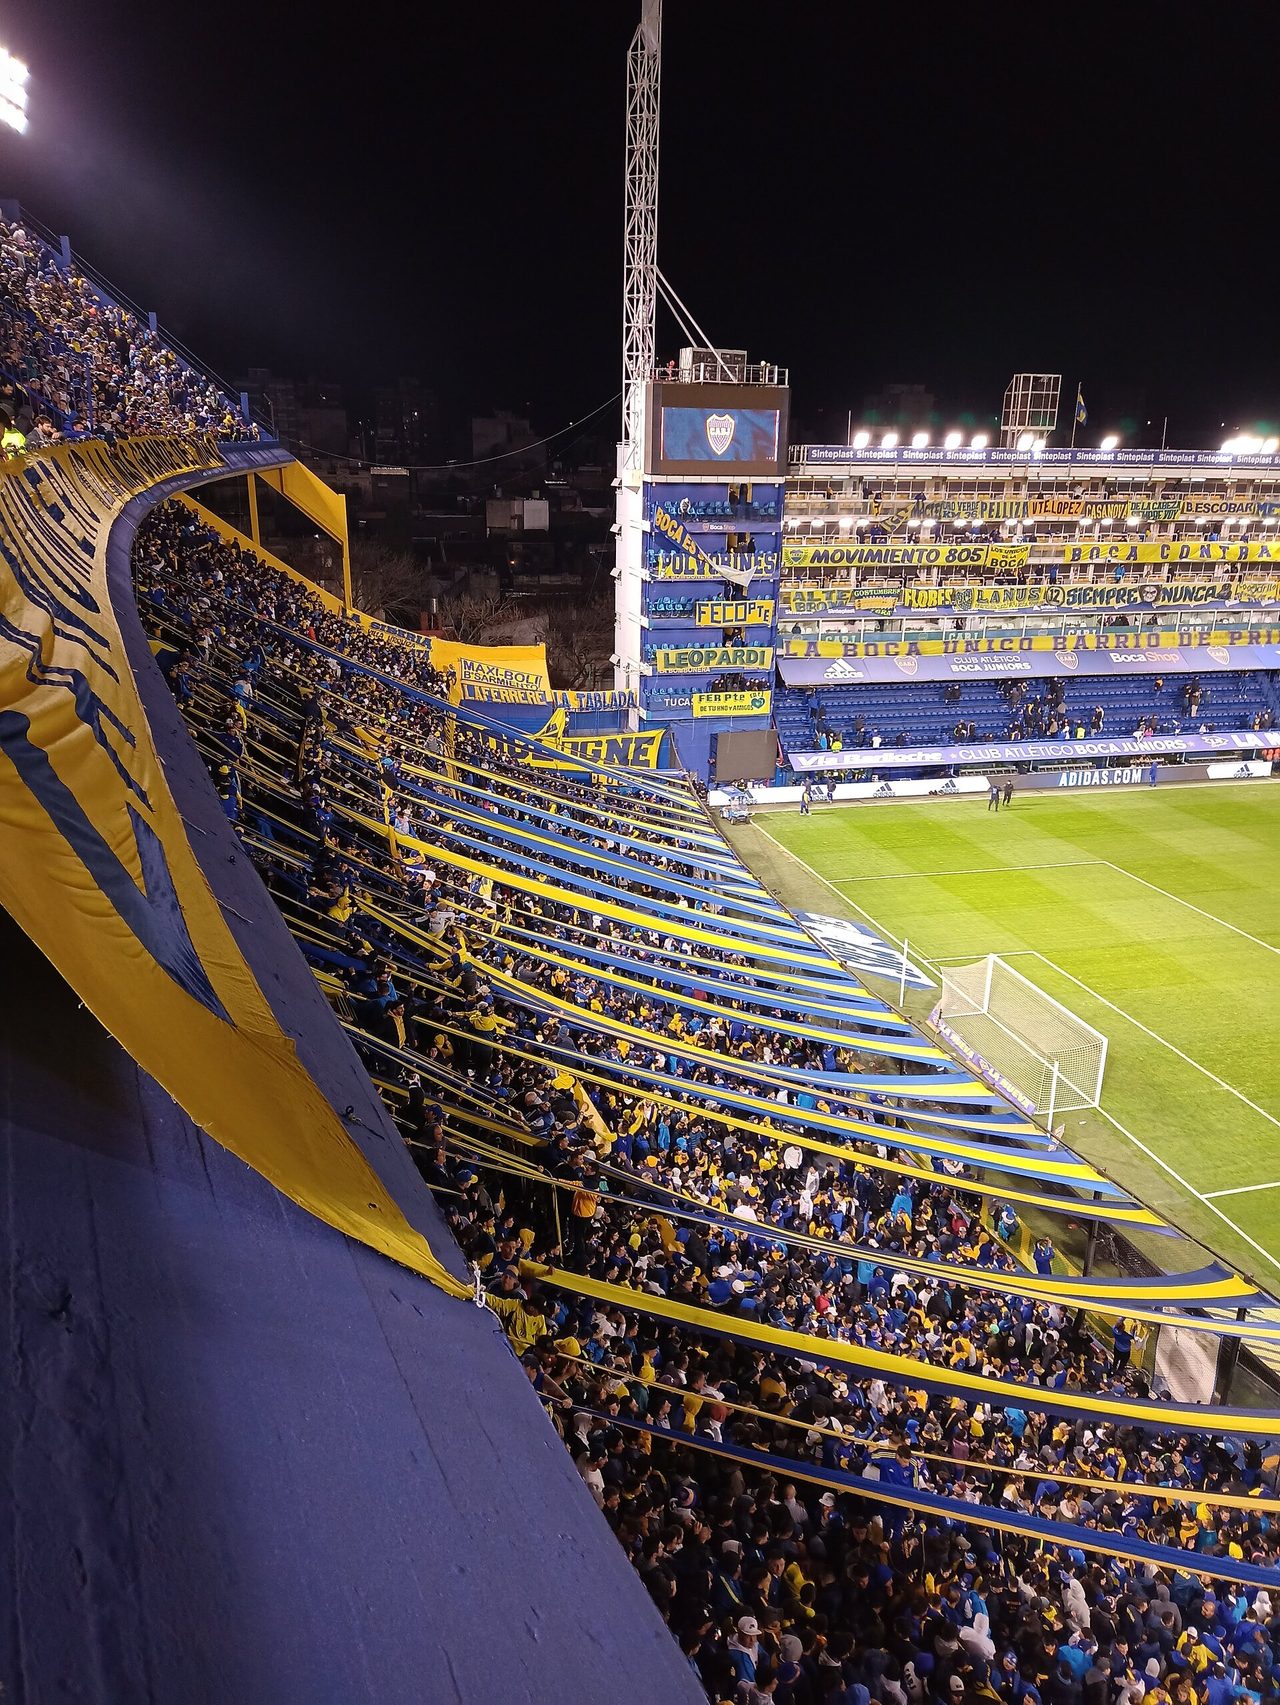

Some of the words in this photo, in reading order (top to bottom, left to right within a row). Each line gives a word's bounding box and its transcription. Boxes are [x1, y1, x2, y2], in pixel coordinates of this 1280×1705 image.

[811, 450, 853, 460] Sinteplast
[856, 450, 898, 460] Sinteplast
[902, 450, 943, 460] Sinteplast
[945, 450, 986, 461] Sinteplast
[991, 451, 1031, 461] Sinteplast
[1076, 452, 1114, 462] Sinteplast
[1117, 452, 1155, 462] Sinteplast
[1158, 452, 1195, 463] Sinteplast
[1236, 455, 1273, 465] Sinteplast
[980, 501, 1029, 518] PELLIZA
[655, 506, 684, 544] BOCA
[810, 548, 940, 564] MOVIMIENTO
[945, 548, 983, 563] 805
[1070, 545, 1139, 561] BOCA
[1160, 544, 1272, 561] CONTRA
[991, 558, 1024, 568] BOCA
[904, 588, 953, 608] FLORES
[977, 588, 1040, 604] LANUS
[1049, 588, 1061, 603] 12
[1066, 584, 1138, 605] SIEMPRE
[1160, 584, 1218, 605] NUNCA
[784, 640, 822, 657] LA
[842, 641, 922, 657] BOCA
[1053, 632, 1160, 651] BARRIO
[1178, 631, 1211, 647] DE
[1229, 630, 1280, 646] PRI
[663, 648, 766, 669] LEOPARDI
[980, 655, 1021, 664] ATLÉTICO
[824, 671, 865, 679] adidas
[951, 663, 982, 672] BOCA
[984, 662, 1032, 671] JUNIORS
[699, 694, 721, 702] FER
[1231, 734, 1266, 748] LA
[958, 748, 1000, 761] CLUB
[1004, 744, 1074, 759] ATLÉTICO
[1077, 743, 1120, 756] BOCA
[1120, 738, 1187, 753] JUNIORS
[1058, 768, 1142, 787] ADIDAS.COM
